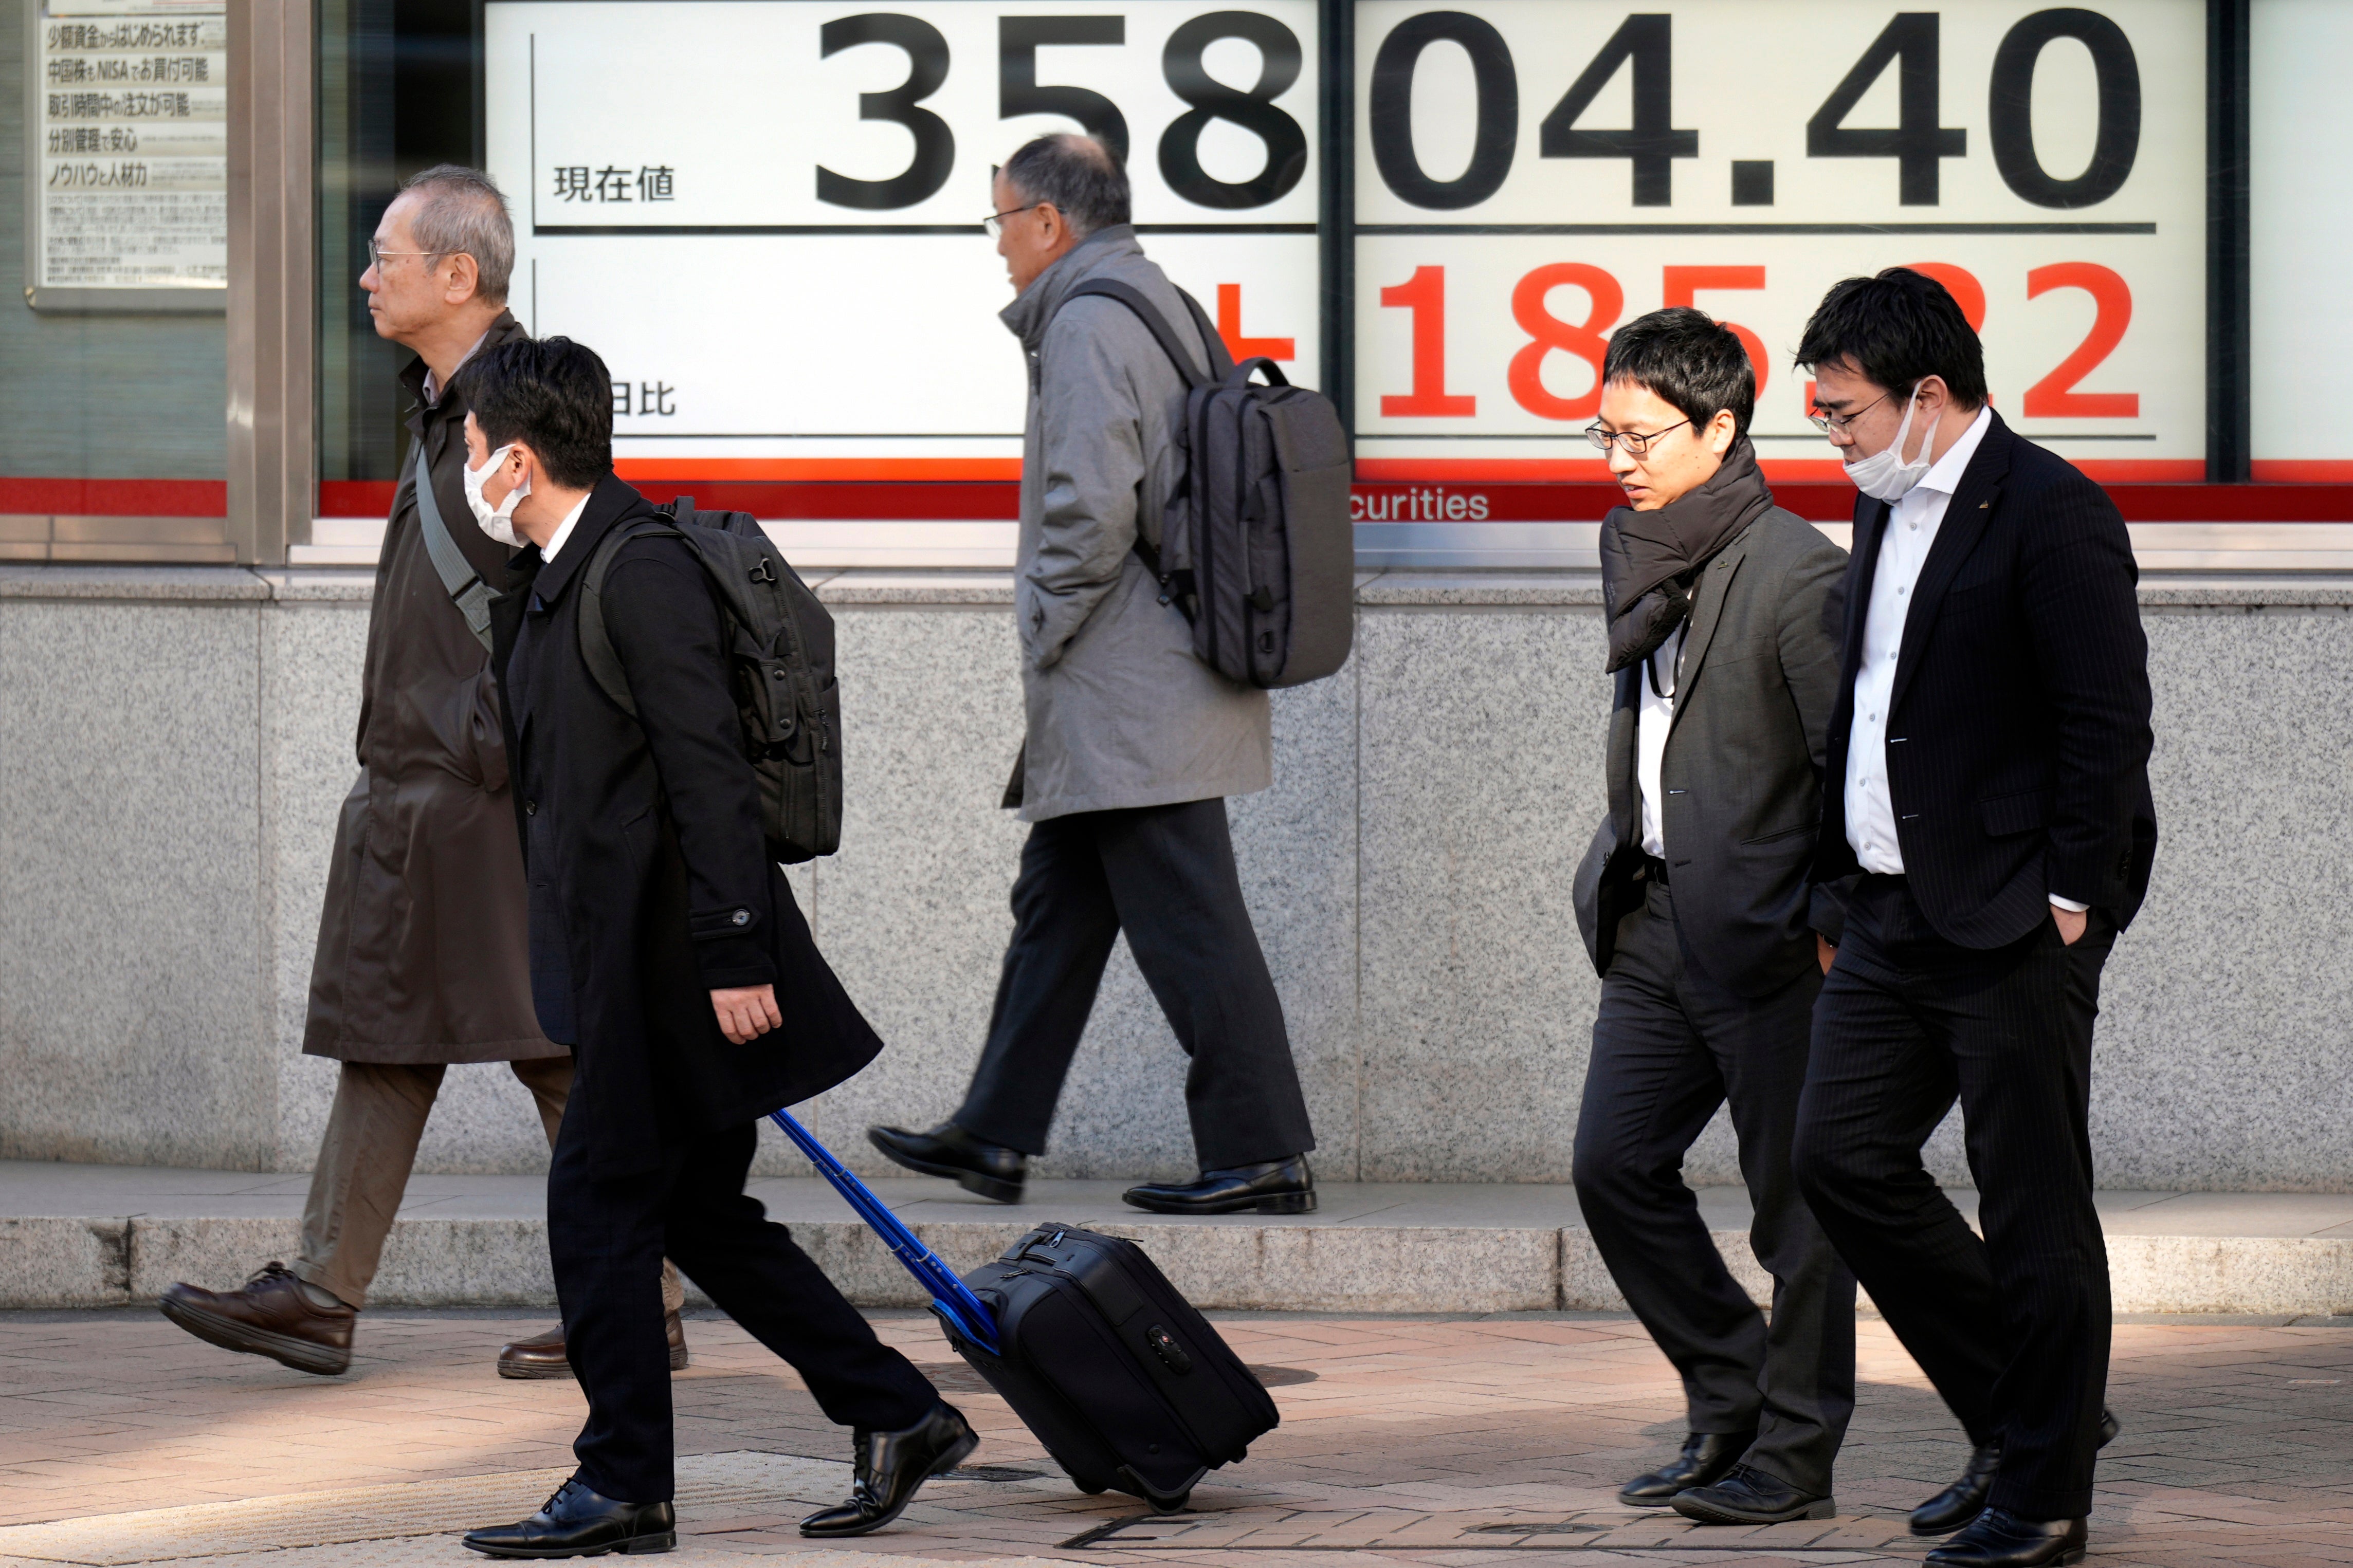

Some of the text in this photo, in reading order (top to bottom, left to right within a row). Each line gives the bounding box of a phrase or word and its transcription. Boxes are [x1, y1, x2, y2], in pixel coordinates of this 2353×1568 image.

[815, 9, 2142, 210] 35804.40
[49, 128, 137, 153] 分別管理で安心
[554, 165, 674, 202] 現在値
[1350, 487, 1488, 520] curities
